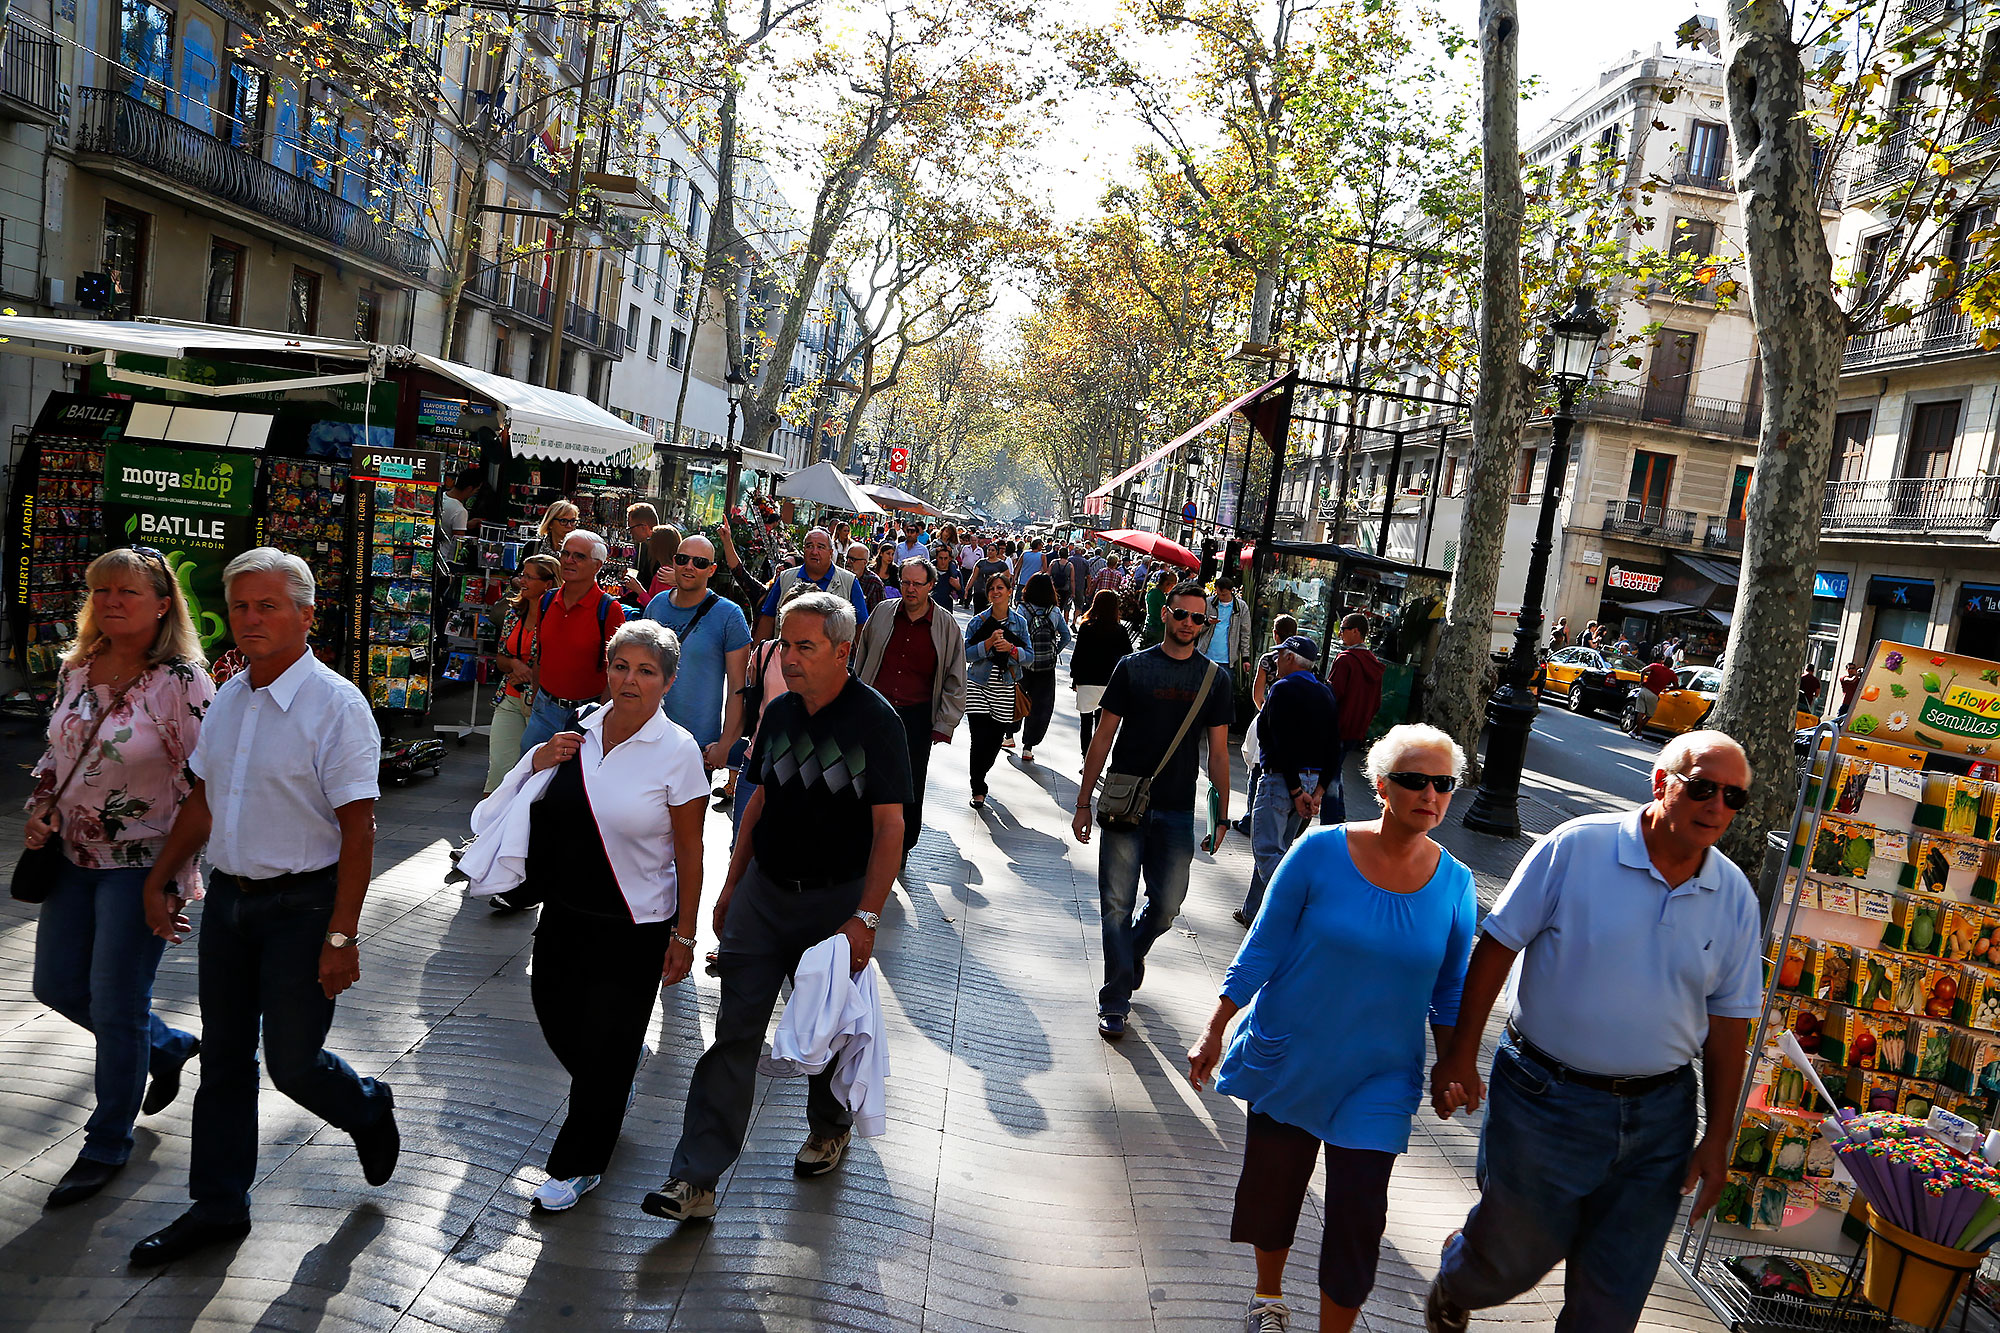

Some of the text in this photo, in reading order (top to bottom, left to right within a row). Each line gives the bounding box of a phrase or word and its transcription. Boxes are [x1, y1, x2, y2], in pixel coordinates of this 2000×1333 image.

[66, 404, 115, 421] BATLLE
[423, 408, 448, 416] SEMILLAS
[435, 425, 463, 436] BATLLE
[121, 467, 232, 499] moyashop
[357, 492, 367, 521] FLORES
[141, 513, 225, 540] BATLLE
[256, 517, 264, 547] RDÍN
[18, 494, 34, 604] HUERTO Y JARDÍN
[140, 535, 177, 545] HUERTO
[189, 540, 225, 550] JARDÍN
[355, 531, 365, 584] LEGUMINOSAS
[1621, 578, 1660, 593] COFFEE
[1622, 571, 1664, 585] DUNKIN'
[353, 593, 363, 640] AROMÁTICAS
[1926, 708, 1999, 735] semillas
